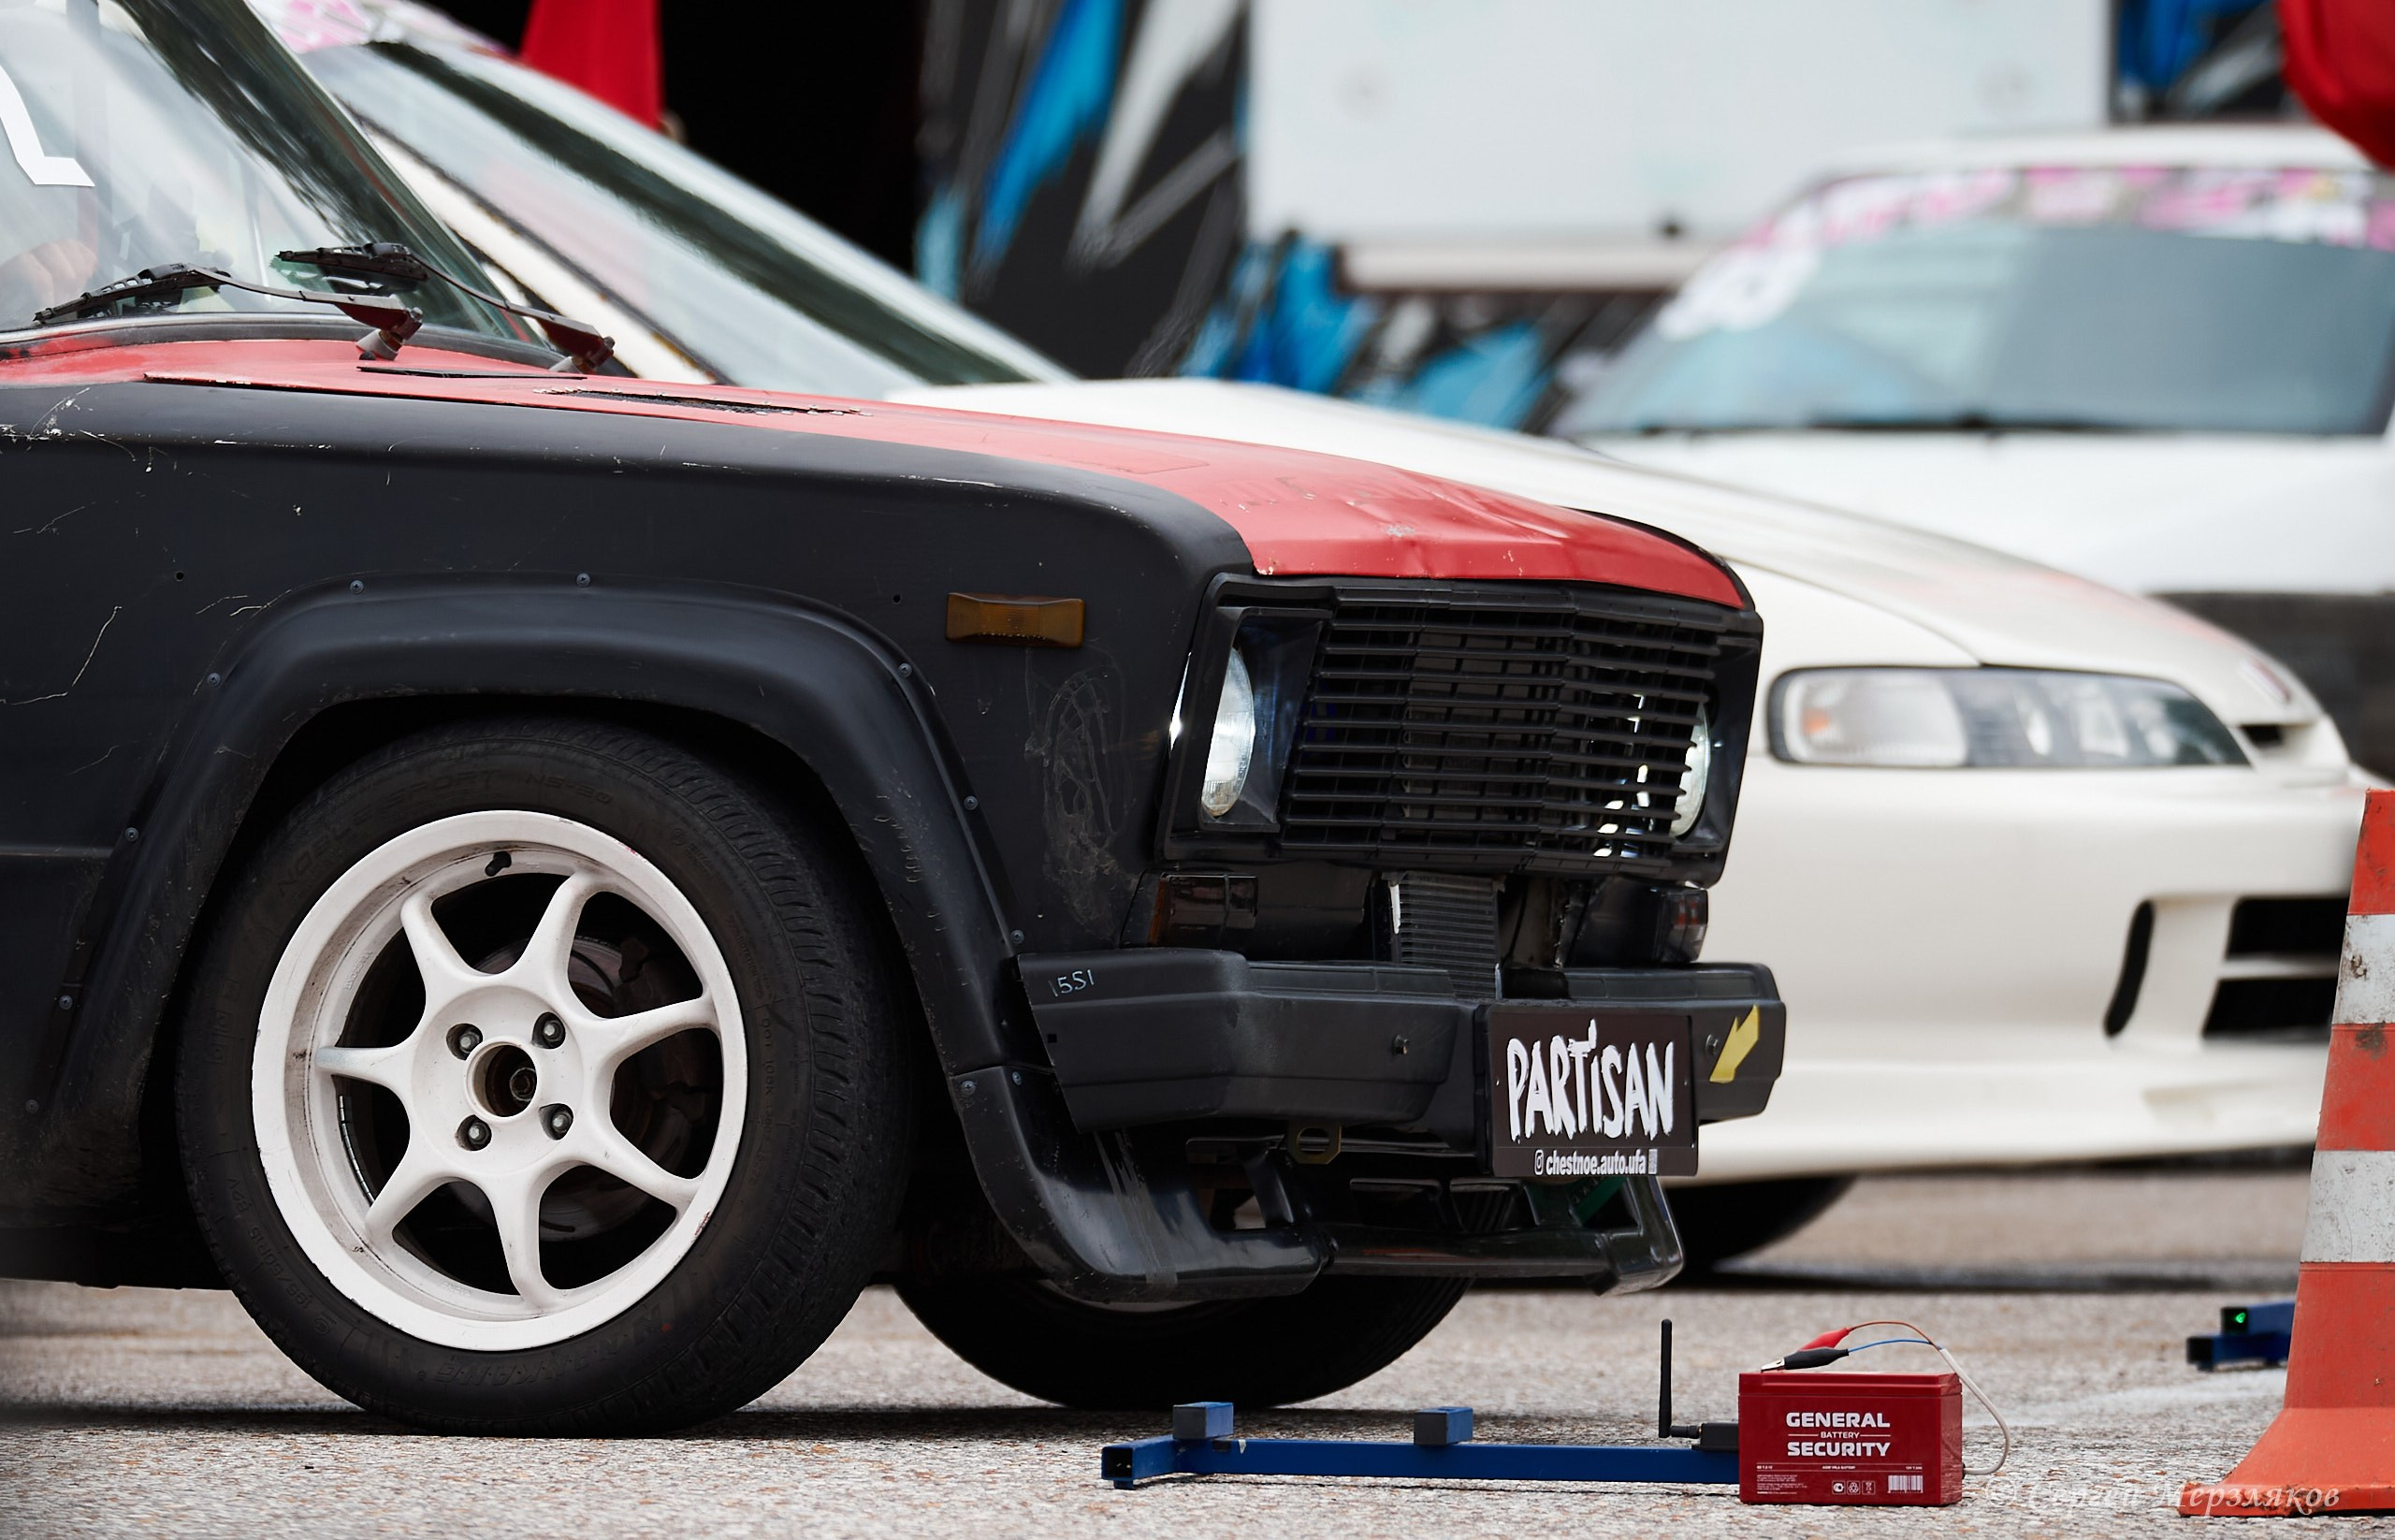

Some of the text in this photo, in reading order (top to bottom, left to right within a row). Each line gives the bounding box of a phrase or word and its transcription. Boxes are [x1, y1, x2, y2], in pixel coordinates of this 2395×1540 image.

[1507, 1019, 1675, 1143] PARTISAN
[1546, 1148, 1647, 1175] chestnoe.auto.ufa
[1786, 1412, 1891, 1428] GENERAL
[1787, 1442, 1891, 1457] SECURITY
